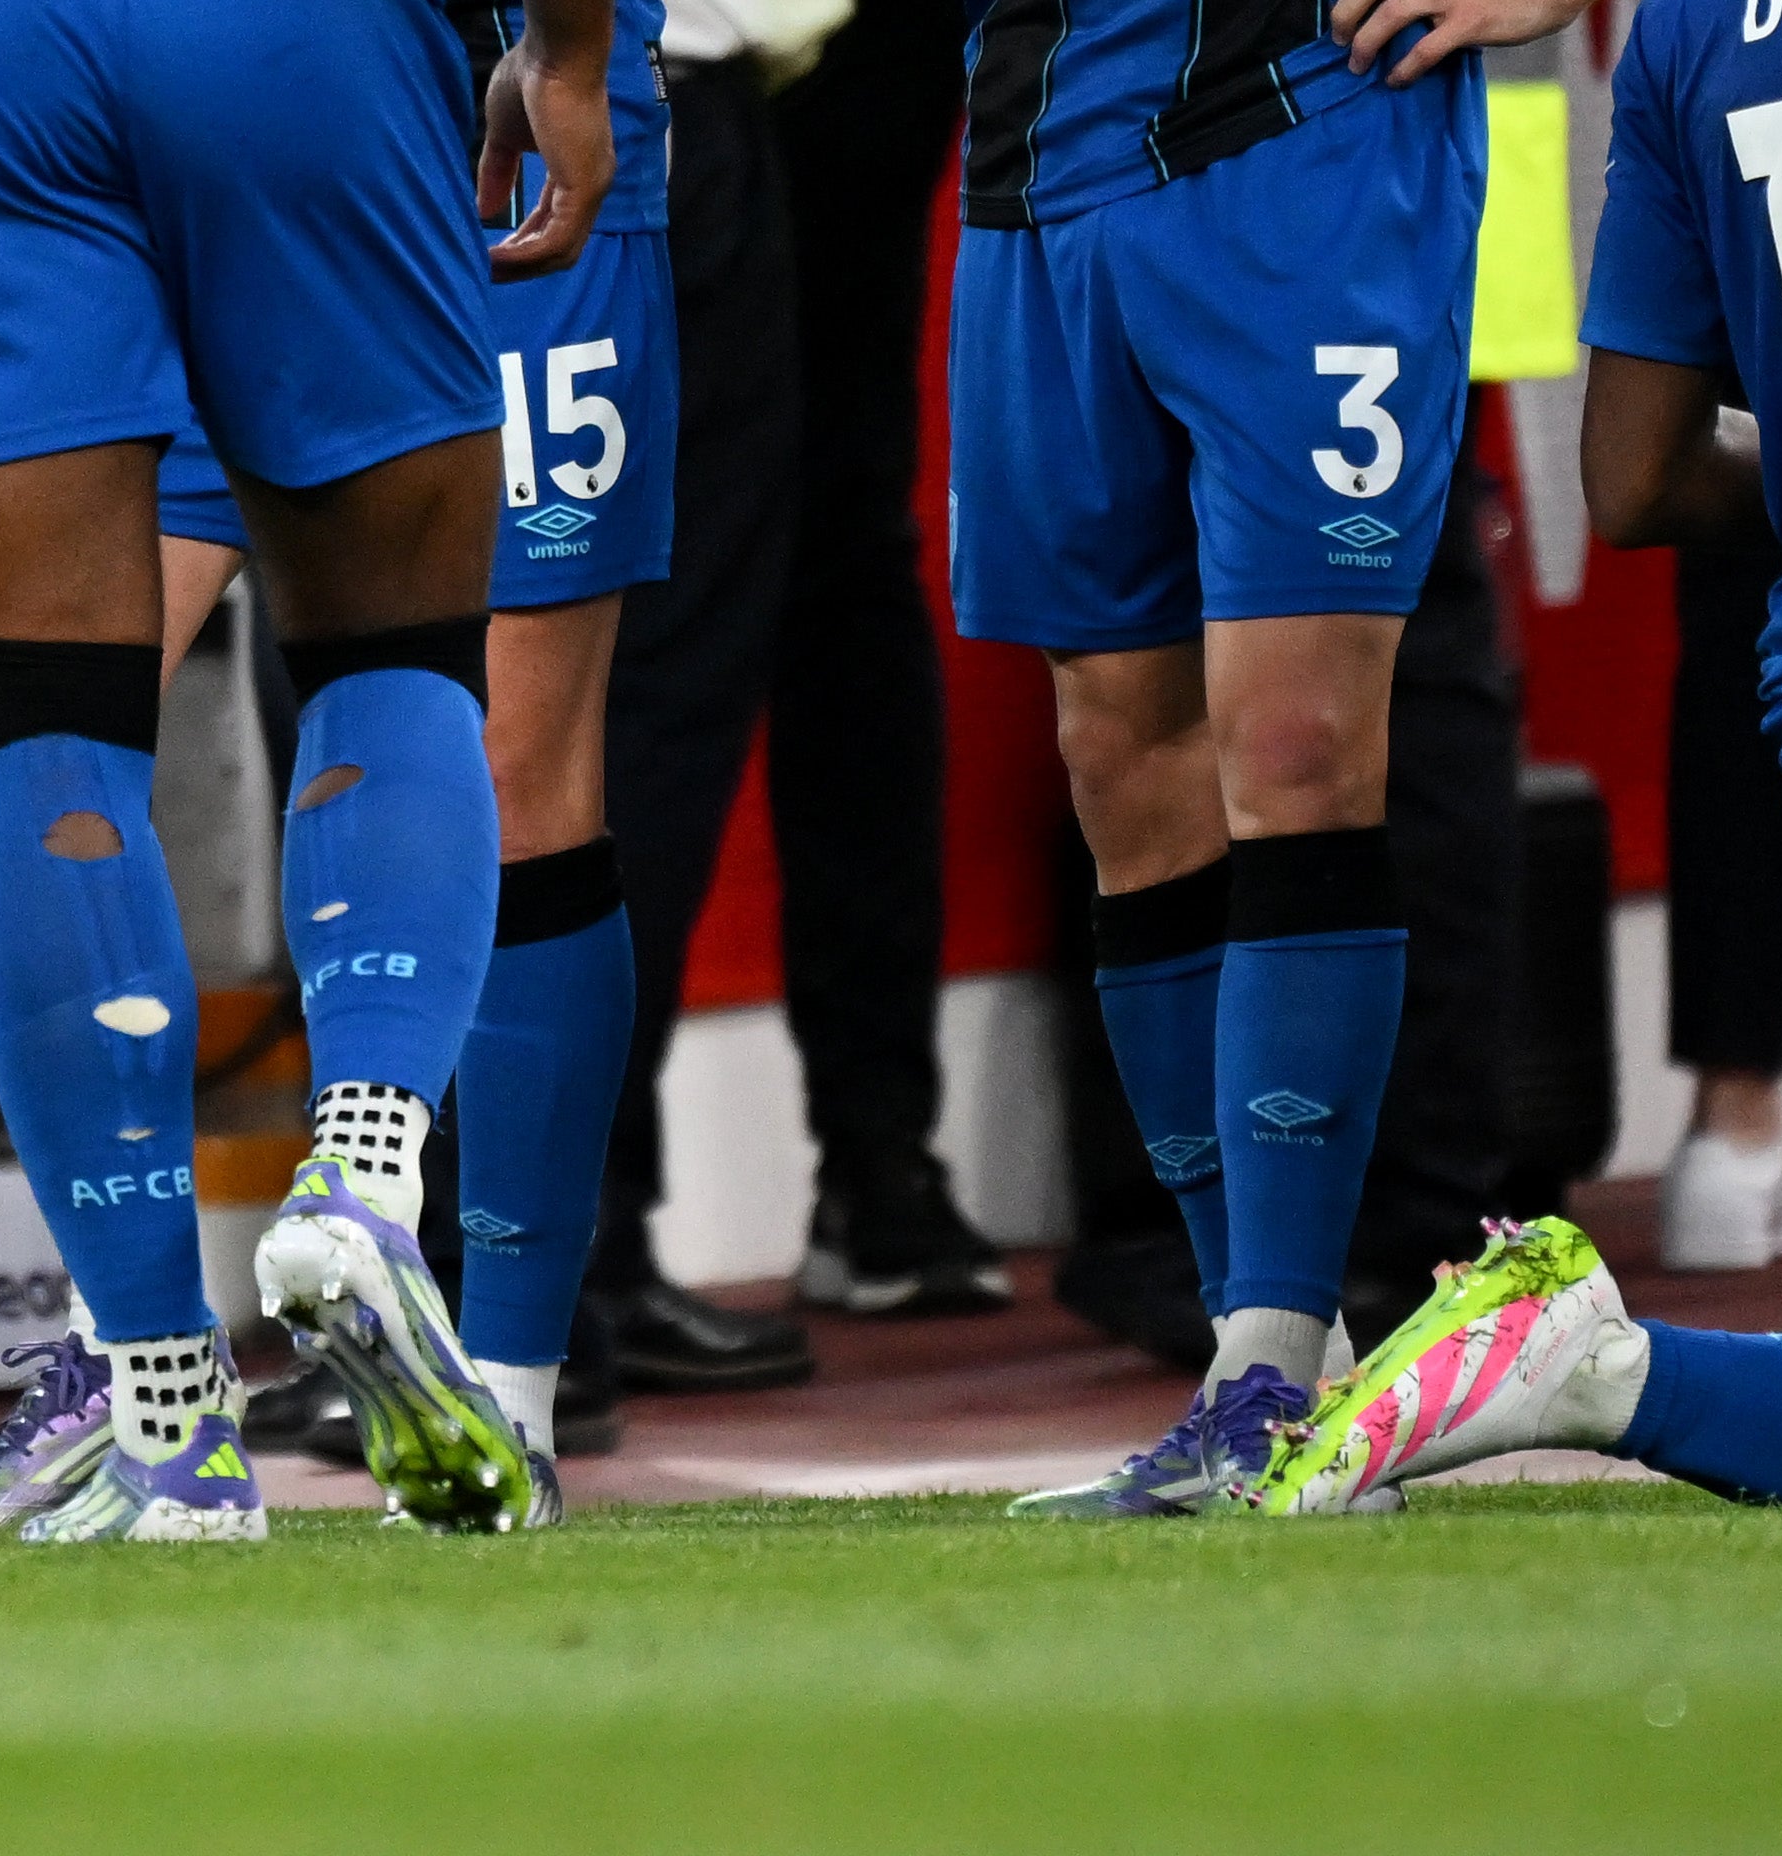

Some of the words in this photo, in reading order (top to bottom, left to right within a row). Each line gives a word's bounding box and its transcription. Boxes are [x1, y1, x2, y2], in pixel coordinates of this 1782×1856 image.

[498, 338, 627, 508] 15
[1311, 345, 1404, 499] 3
[527, 541, 591, 560] umbro
[1328, 551, 1392, 569] umbro
[71, 1166, 195, 1209] AFCB
